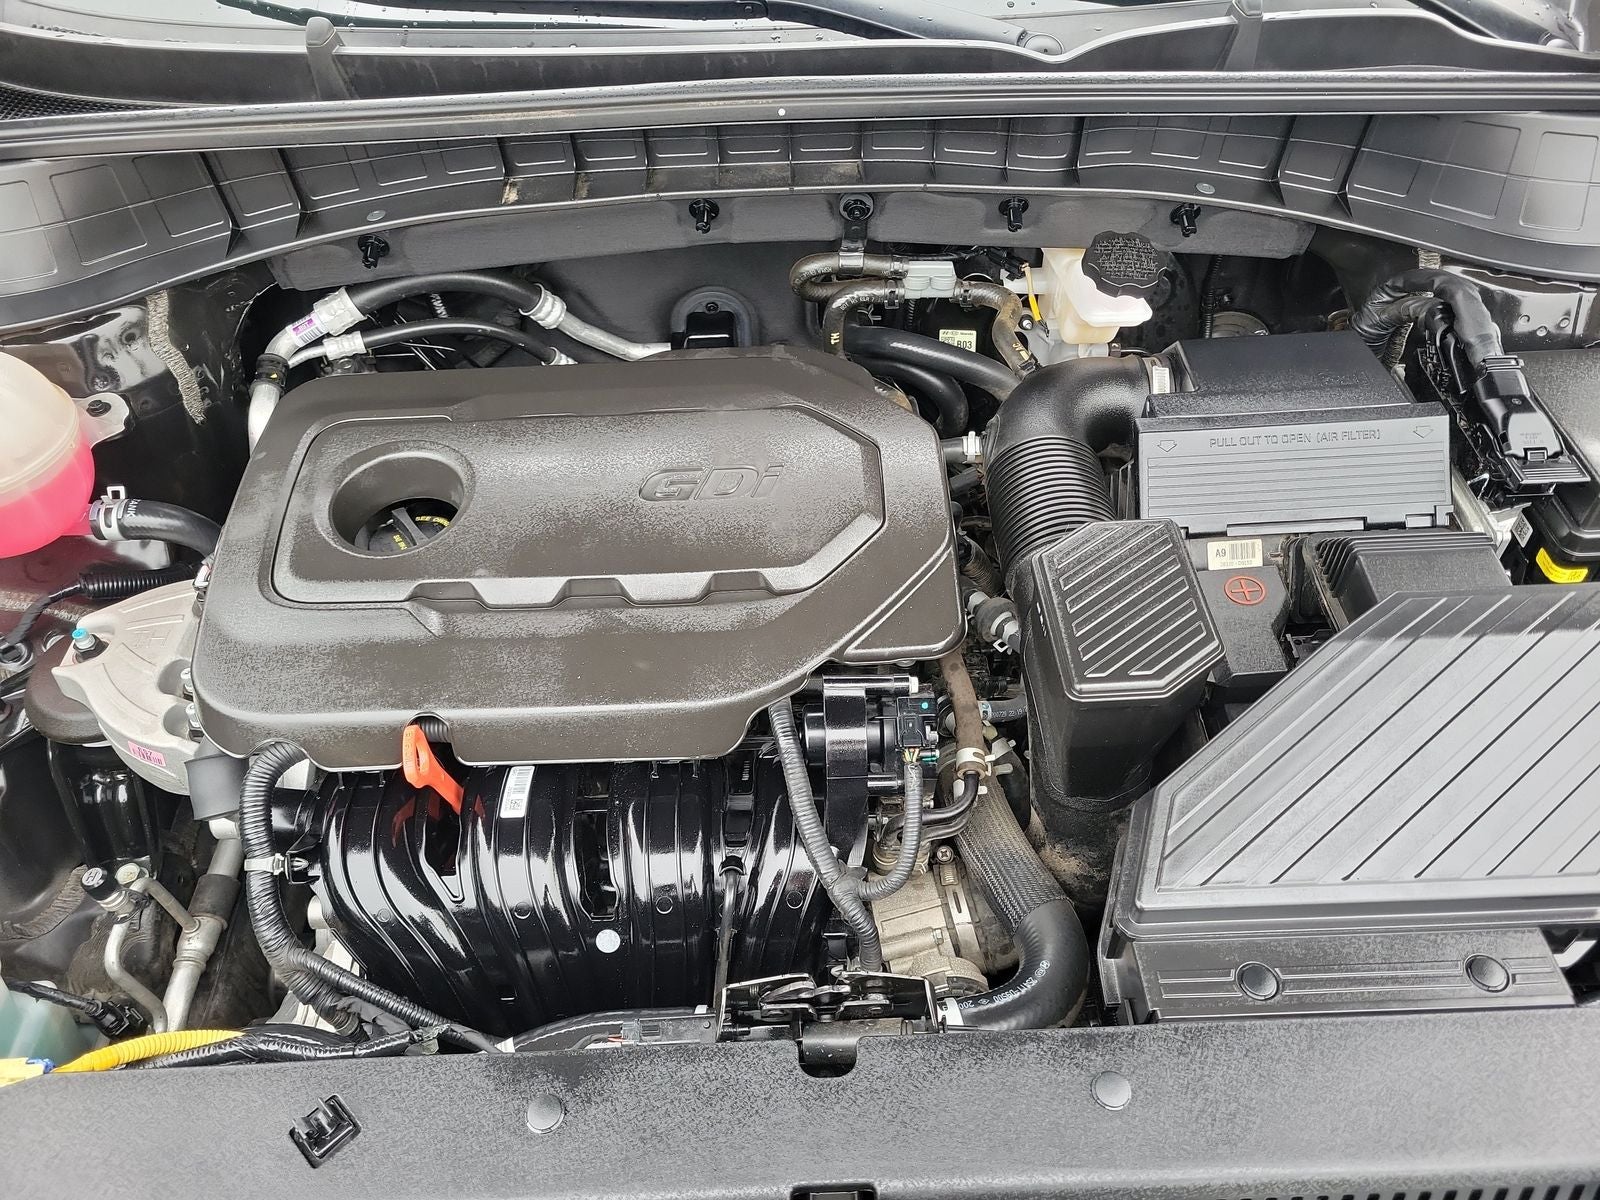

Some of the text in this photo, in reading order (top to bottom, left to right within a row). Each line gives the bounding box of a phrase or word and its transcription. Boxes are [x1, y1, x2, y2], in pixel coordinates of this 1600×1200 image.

[1209, 437, 1237, 448] PULL
[1239, 435, 1261, 446] OUT
[1264, 434, 1279, 444] TO
[1281, 432, 1312, 444] OPEN
[1215, 548, 1227, 558] A9
